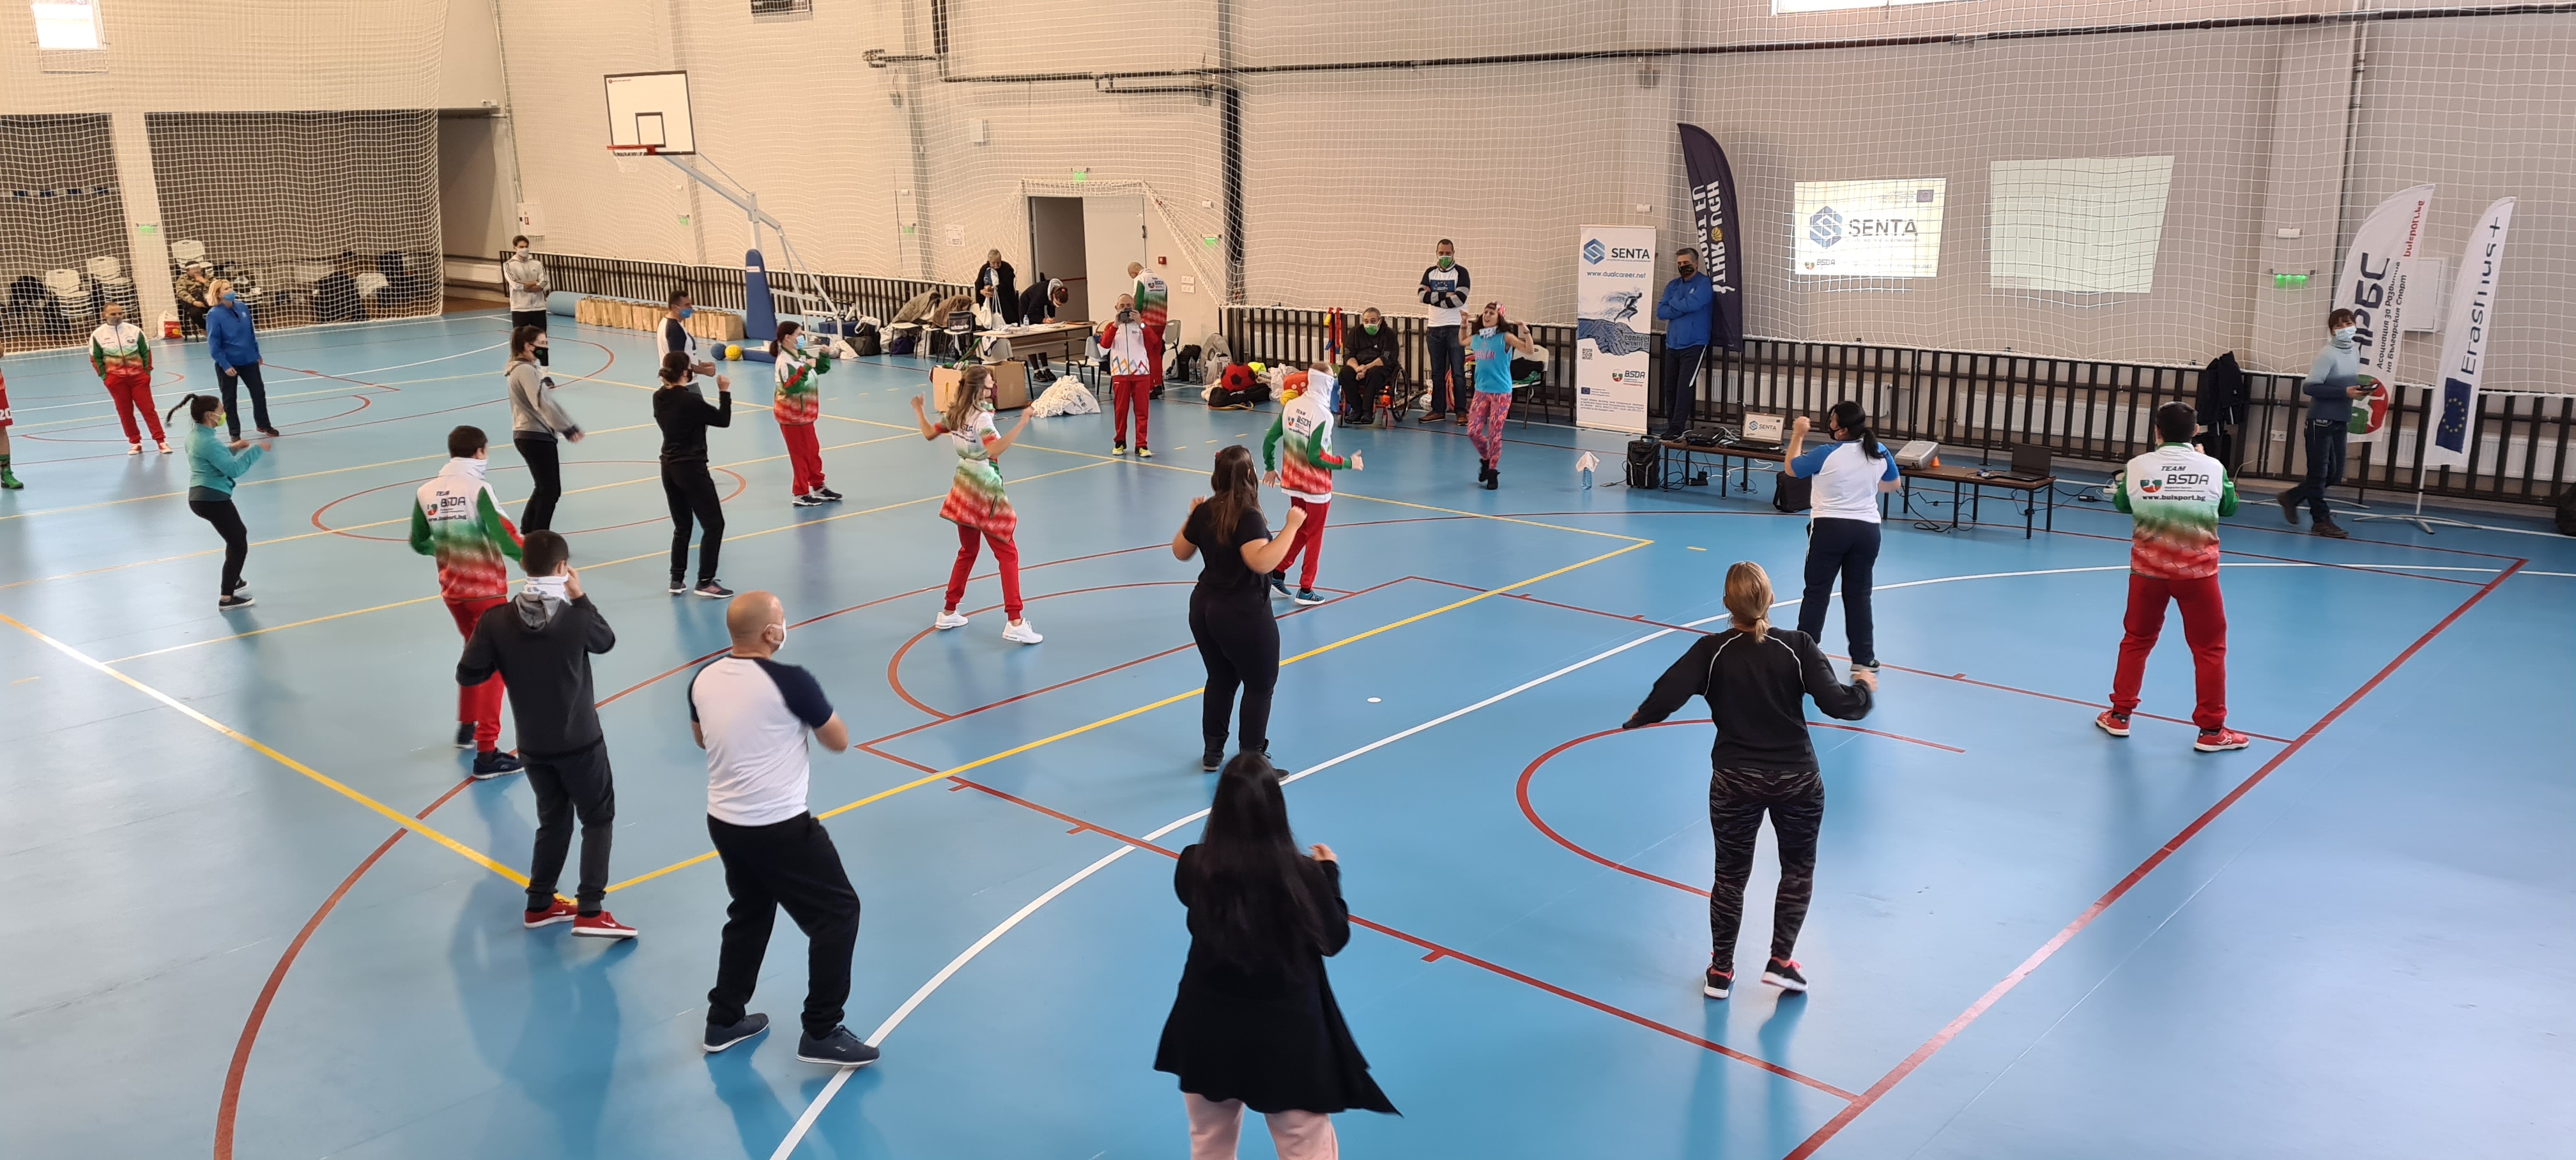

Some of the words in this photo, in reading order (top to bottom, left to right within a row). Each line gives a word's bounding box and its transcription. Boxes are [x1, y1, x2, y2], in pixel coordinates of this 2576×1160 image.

[1848, 219, 1918, 236] SENTA
[1611, 248, 1650, 259] SENTA
[2396, 275, 2407, 305] Спорт
[2460, 217, 2501, 375] Erasmus+
[2377, 320, 2389, 370] Асоциация
[2384, 309, 2392, 320] за
[2388, 307, 2401, 360] Българския
[1625, 370, 1646, 379] BSDA
[2386, 361, 2393, 373] на
[2166, 474, 2209, 485] BSDA
